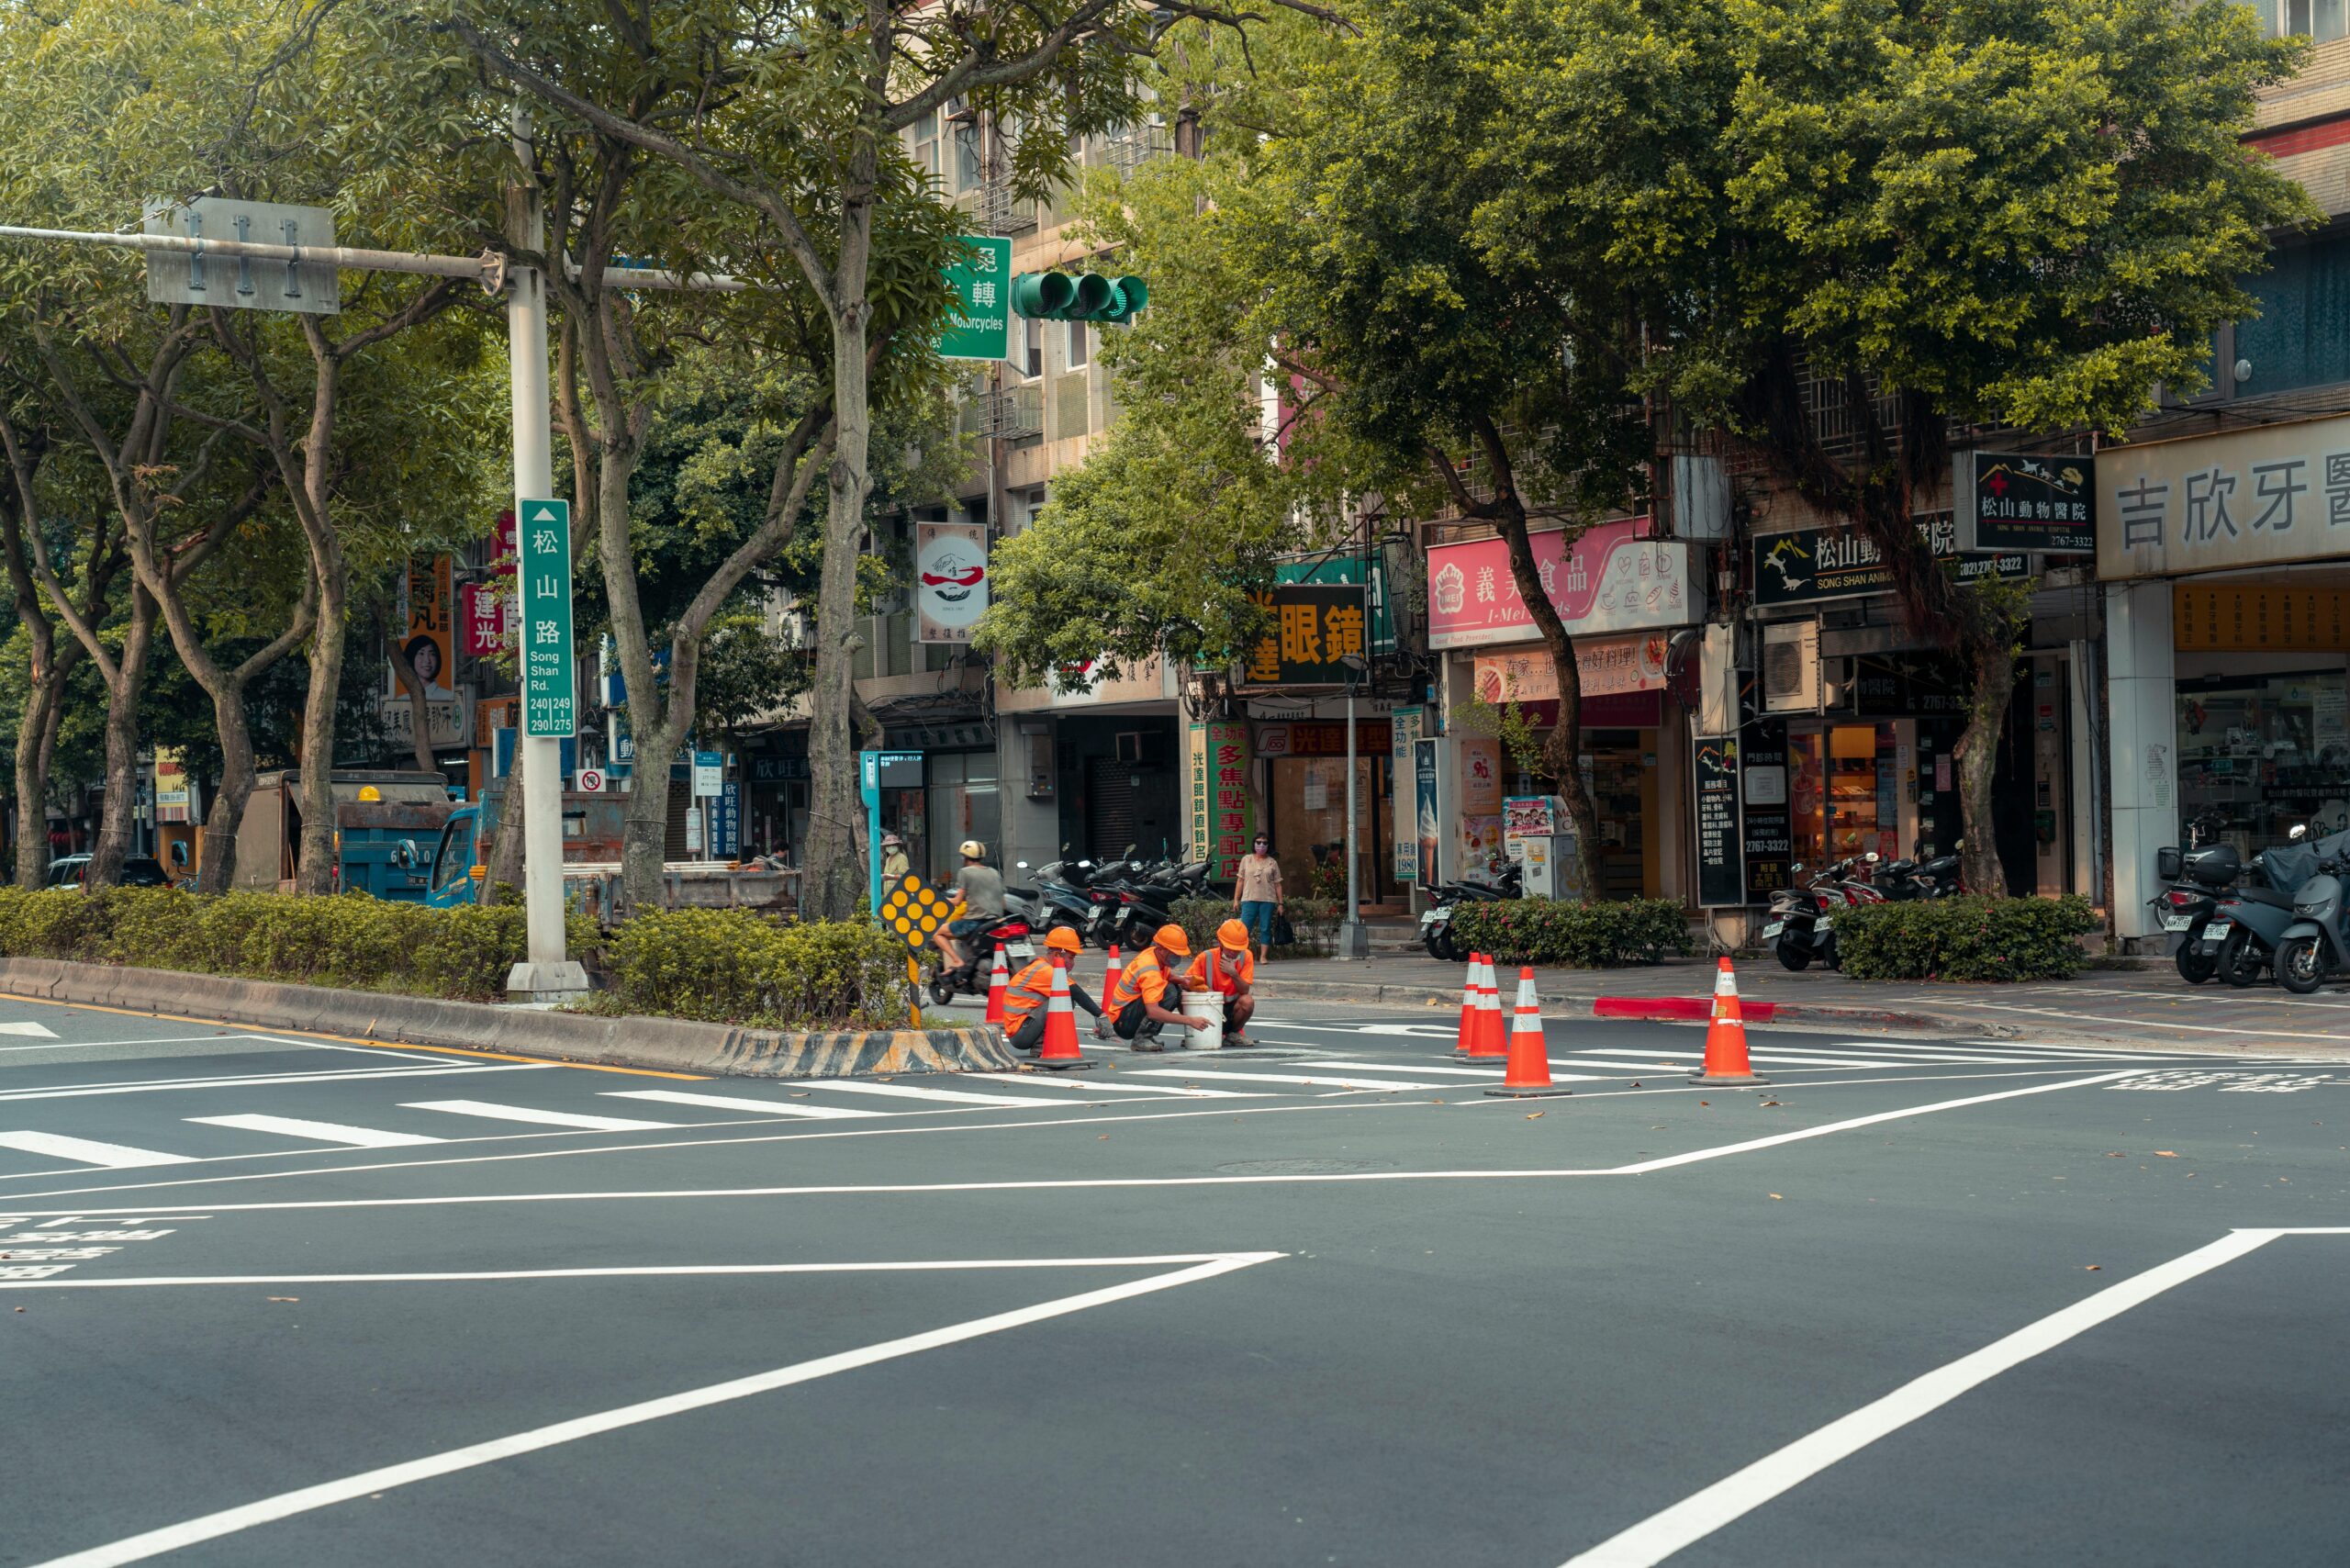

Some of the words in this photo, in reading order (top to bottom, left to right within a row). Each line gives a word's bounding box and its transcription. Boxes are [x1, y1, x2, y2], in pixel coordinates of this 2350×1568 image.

[950, 313, 1003, 332] Motorcycles
[1981, 496, 2086, 521] 松山動物醫院
[2013, 524, 2025, 532] SHAN
[2051, 535, 2093, 547] 2767-3322
[1476, 554, 1589, 603] 義美食品
[1818, 576, 1842, 589] SONG
[1843, 574, 1866, 587] SHAN
[532, 530, 560, 644] 松山路
[1441, 594, 1460, 605] IMEI
[474, 590, 497, 649] 建光
[1281, 604, 1364, 665] 眼鏡
[1435, 636, 1449, 644] Good
[1450, 635, 1463, 644] Food
[530, 651, 560, 664] Song
[531, 666, 559, 677] Shan
[531, 680, 550, 691] Rd.
[530, 698, 548, 710] 240
[553, 698, 571, 710] 249
[531, 720, 549, 731] 290
[554, 719, 572, 731] 275
[1394, 716, 1407, 759] 全功能
[1410, 714, 1421, 756] 多焦
[1217, 745, 1246, 879] 多焦點專配店
[711, 796, 720, 855] 旺動物醫院
[724, 784, 738, 855] 欣旺動物醫院
[1746, 839, 1789, 853] 2767-3322
[1397, 858, 1416, 872] 1980
